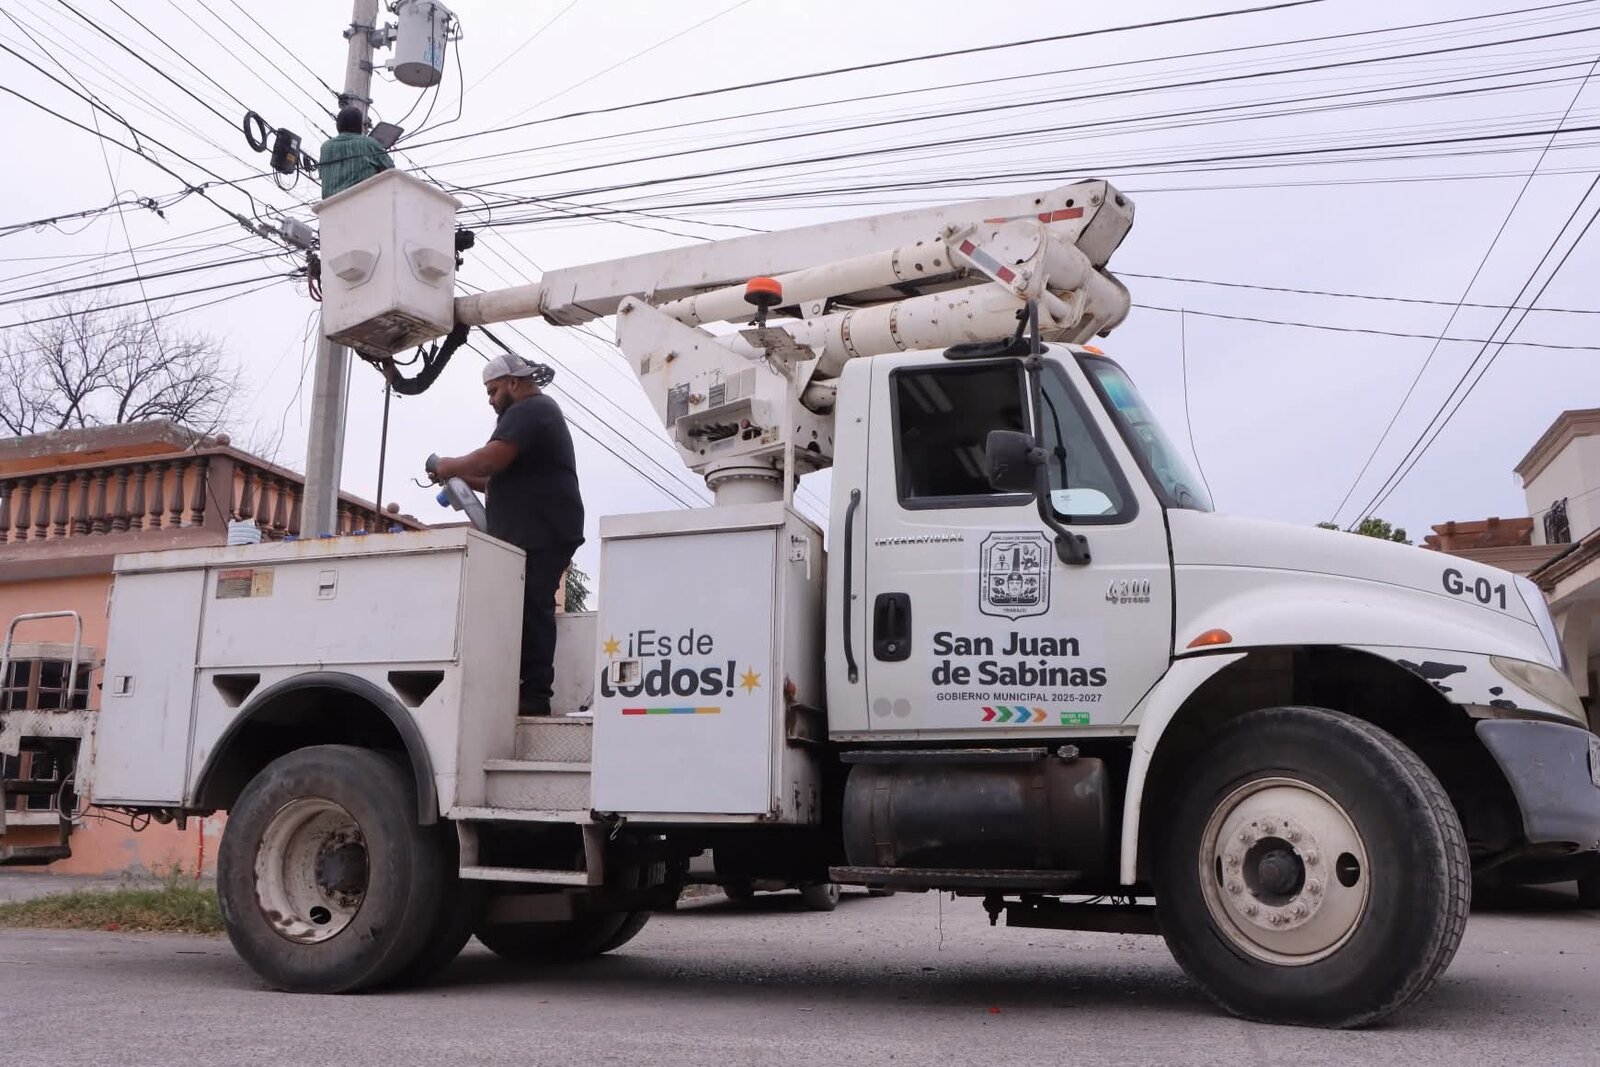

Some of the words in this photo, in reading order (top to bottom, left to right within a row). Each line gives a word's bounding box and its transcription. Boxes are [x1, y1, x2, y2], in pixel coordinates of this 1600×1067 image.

[875, 533, 964, 546] INTERNATIONAL
[1105, 578, 1150, 604] 4300
[1442, 568, 1506, 610] G-01
[678, 628, 714, 656] de
[933, 631, 994, 656] San
[1002, 631, 1080, 656] Juan
[932, 660, 971, 686] de
[978, 659, 1107, 687] Sabinas
[936, 692, 990, 701] GOBIERNO
[993, 692, 1049, 701] MUNICIPAL
[1051, 693, 1103, 702] 2025-2027
